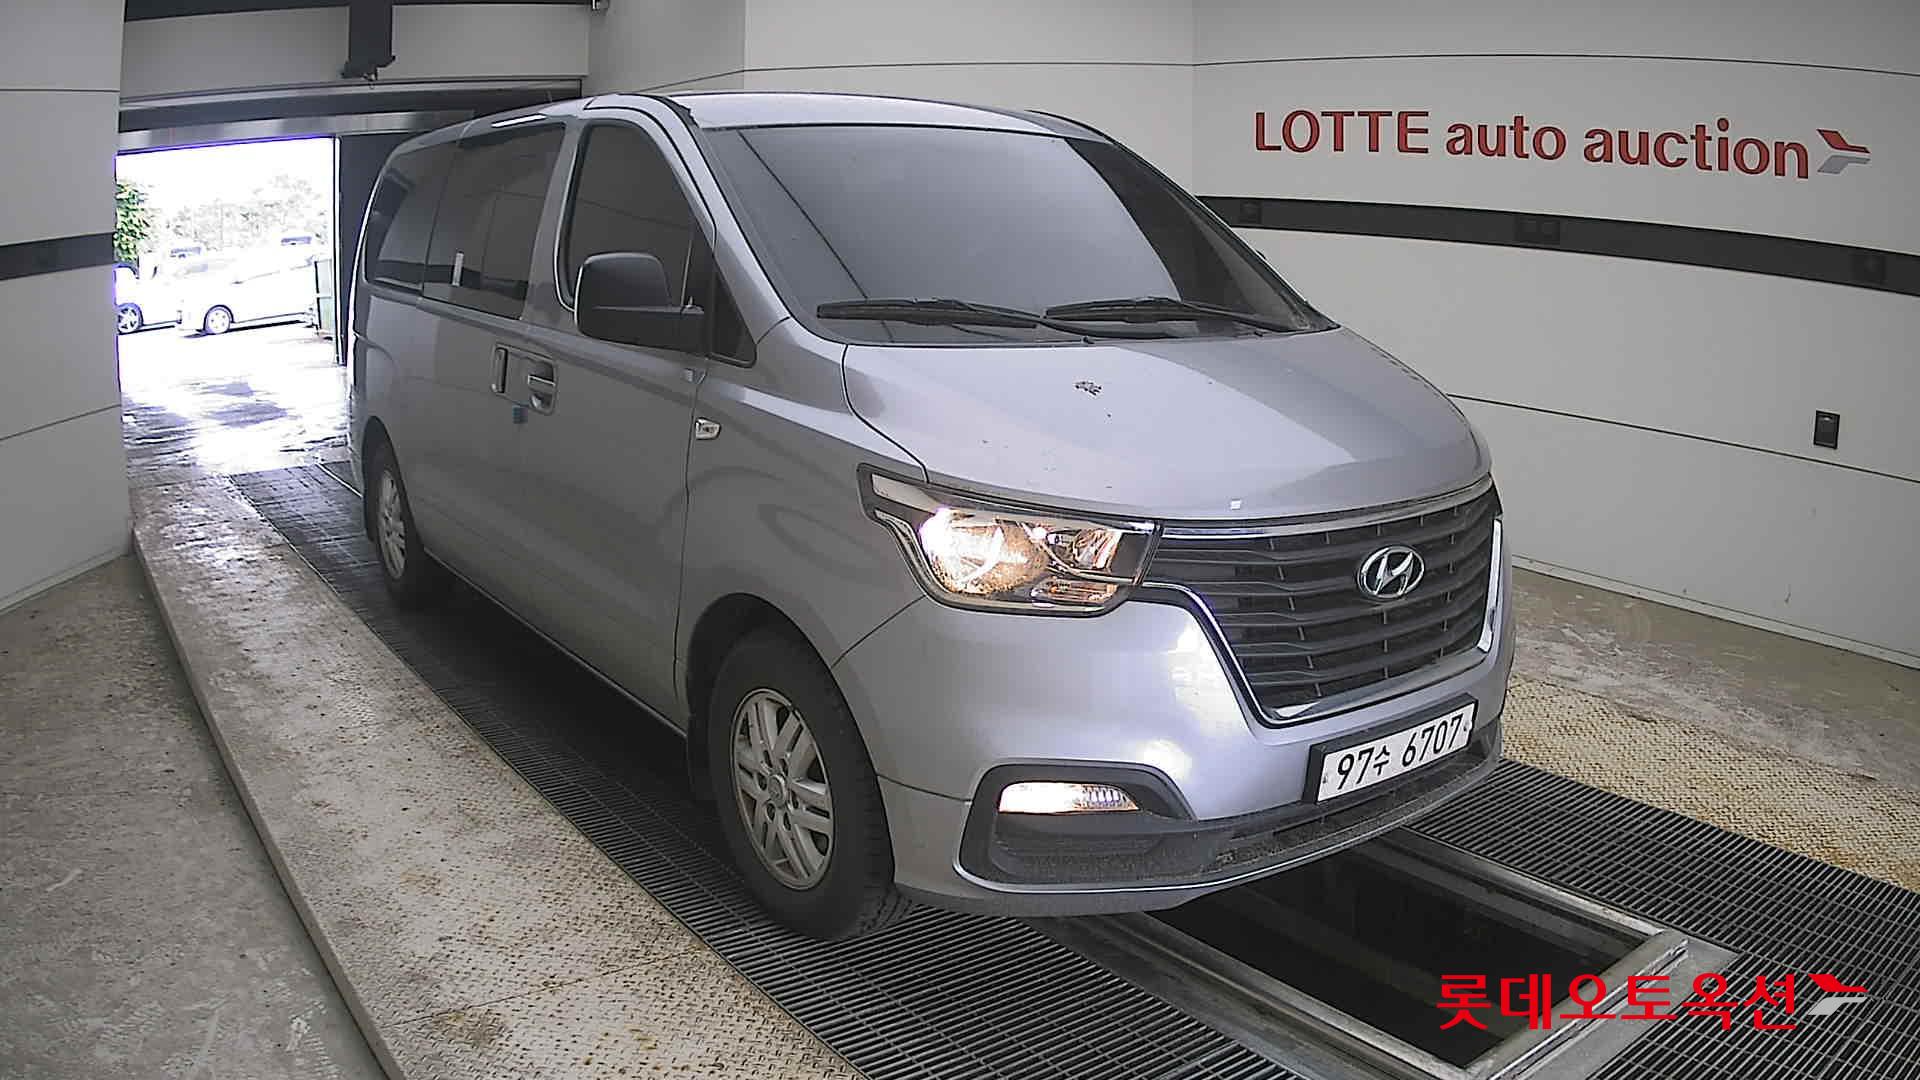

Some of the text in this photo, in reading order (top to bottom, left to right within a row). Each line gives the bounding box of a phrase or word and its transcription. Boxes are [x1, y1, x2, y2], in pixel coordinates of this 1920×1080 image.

[1254, 110, 1809, 179] LOTTE auto auction
[1337, 713, 1464, 790] 97수 6707
